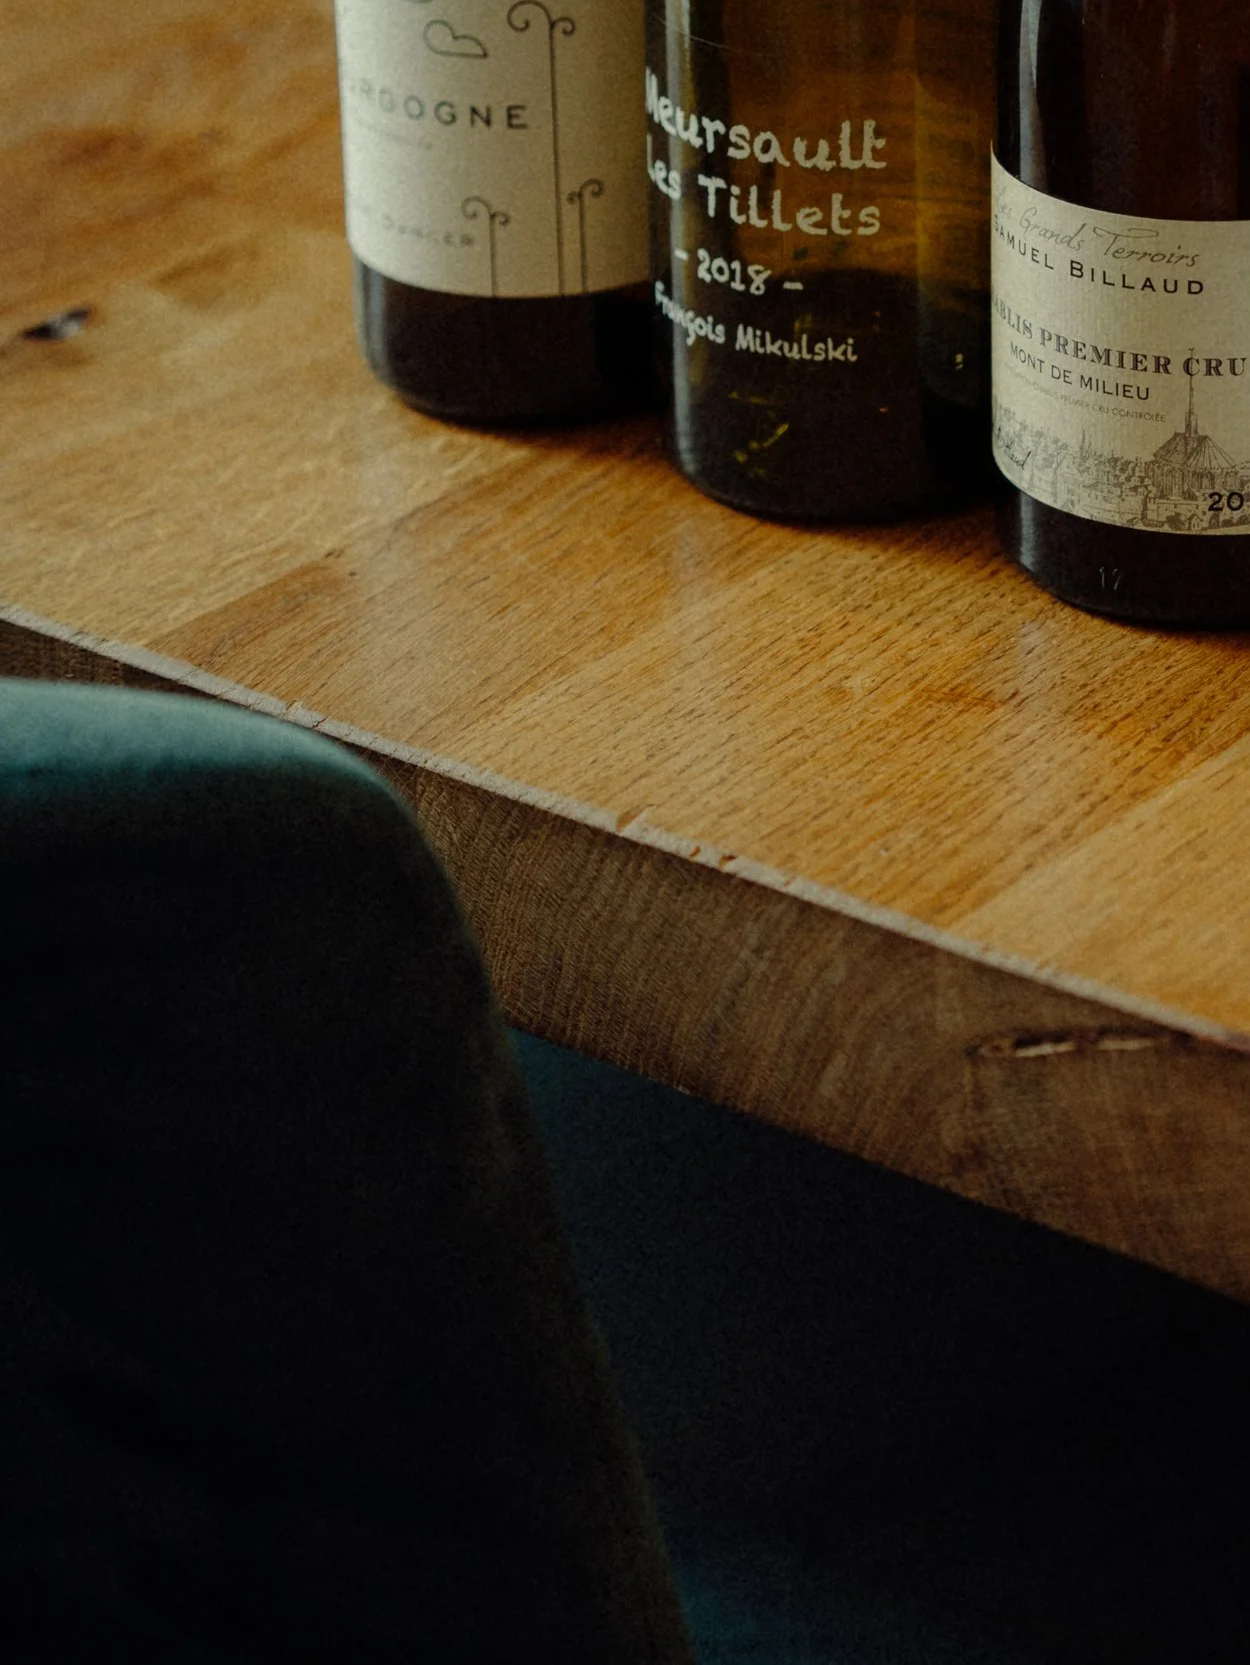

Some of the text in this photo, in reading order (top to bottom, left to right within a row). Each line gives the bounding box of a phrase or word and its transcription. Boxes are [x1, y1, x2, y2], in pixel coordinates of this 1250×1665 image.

[697, 172, 882, 237] Tillets
[1018, 205, 1088, 253] Grands
[1092, 225, 1201, 270] Terroirs
[697, 247, 773, 297] 2018
[1069, 258, 1206, 297] BILLAUD
[654, 280, 859, 363] François Mikulski
[1039, 325, 1174, 377] PREMIER
[1182, 354, 1249, 378] CRU
[1009, 340, 1046, 375] MONT
[1050, 364, 1073, 385] DE
[1079, 373, 1151, 402] MILIEU
